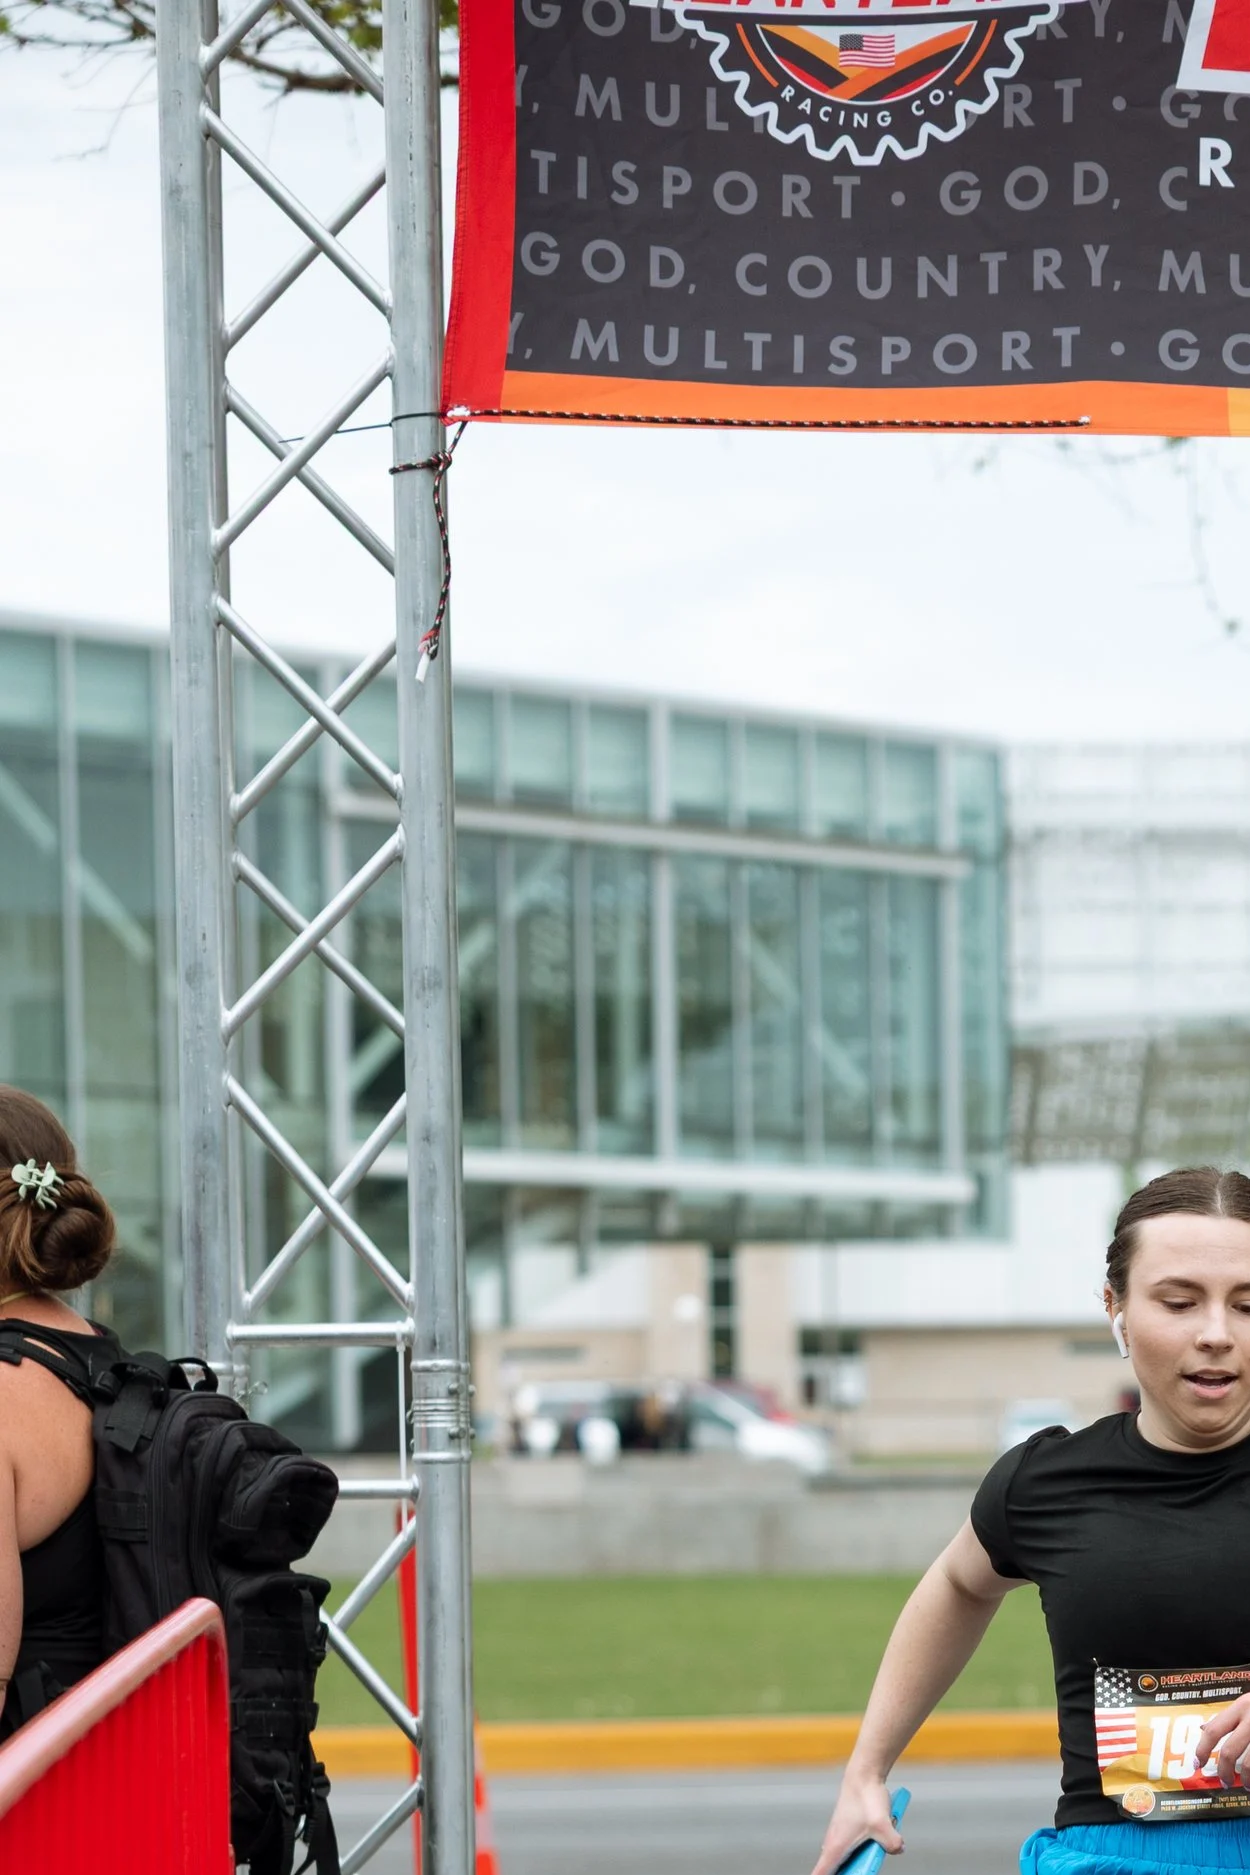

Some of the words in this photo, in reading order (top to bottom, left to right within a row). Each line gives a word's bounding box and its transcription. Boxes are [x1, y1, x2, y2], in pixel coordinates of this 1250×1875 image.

[781, 84, 892, 128] RACING
[911, 89, 954, 116] CO.
[530, 149, 861, 219] TISPORT
[939, 161, 1121, 212] GOD,
[520, 231, 696, 295] GOD,
[735, 244, 1122, 299] COUNTRY,
[570, 319, 1082, 376] MULTISPORT
